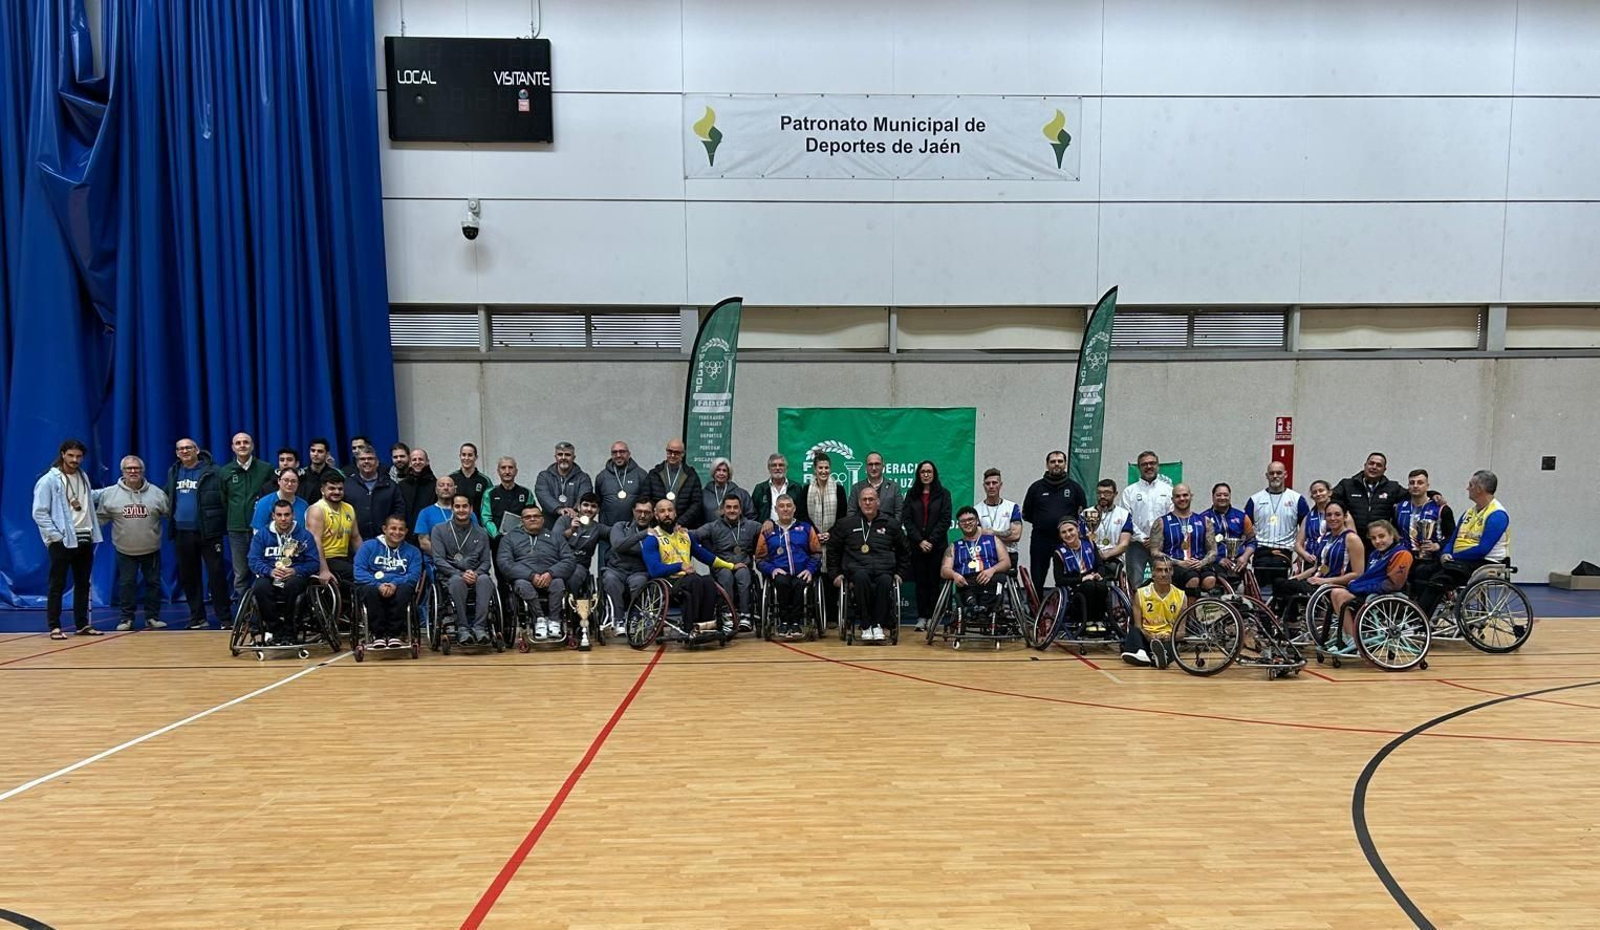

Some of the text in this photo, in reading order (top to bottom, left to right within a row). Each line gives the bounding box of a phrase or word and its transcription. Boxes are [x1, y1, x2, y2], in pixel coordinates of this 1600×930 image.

[397, 70, 437, 85] LOCAL
[493, 71, 550, 86] VISITANTE
[780, 115, 986, 136] Patronato Municipal de
[805, 137, 961, 156] Deportes de Jaén
[1146, 602, 1154, 613] 2
